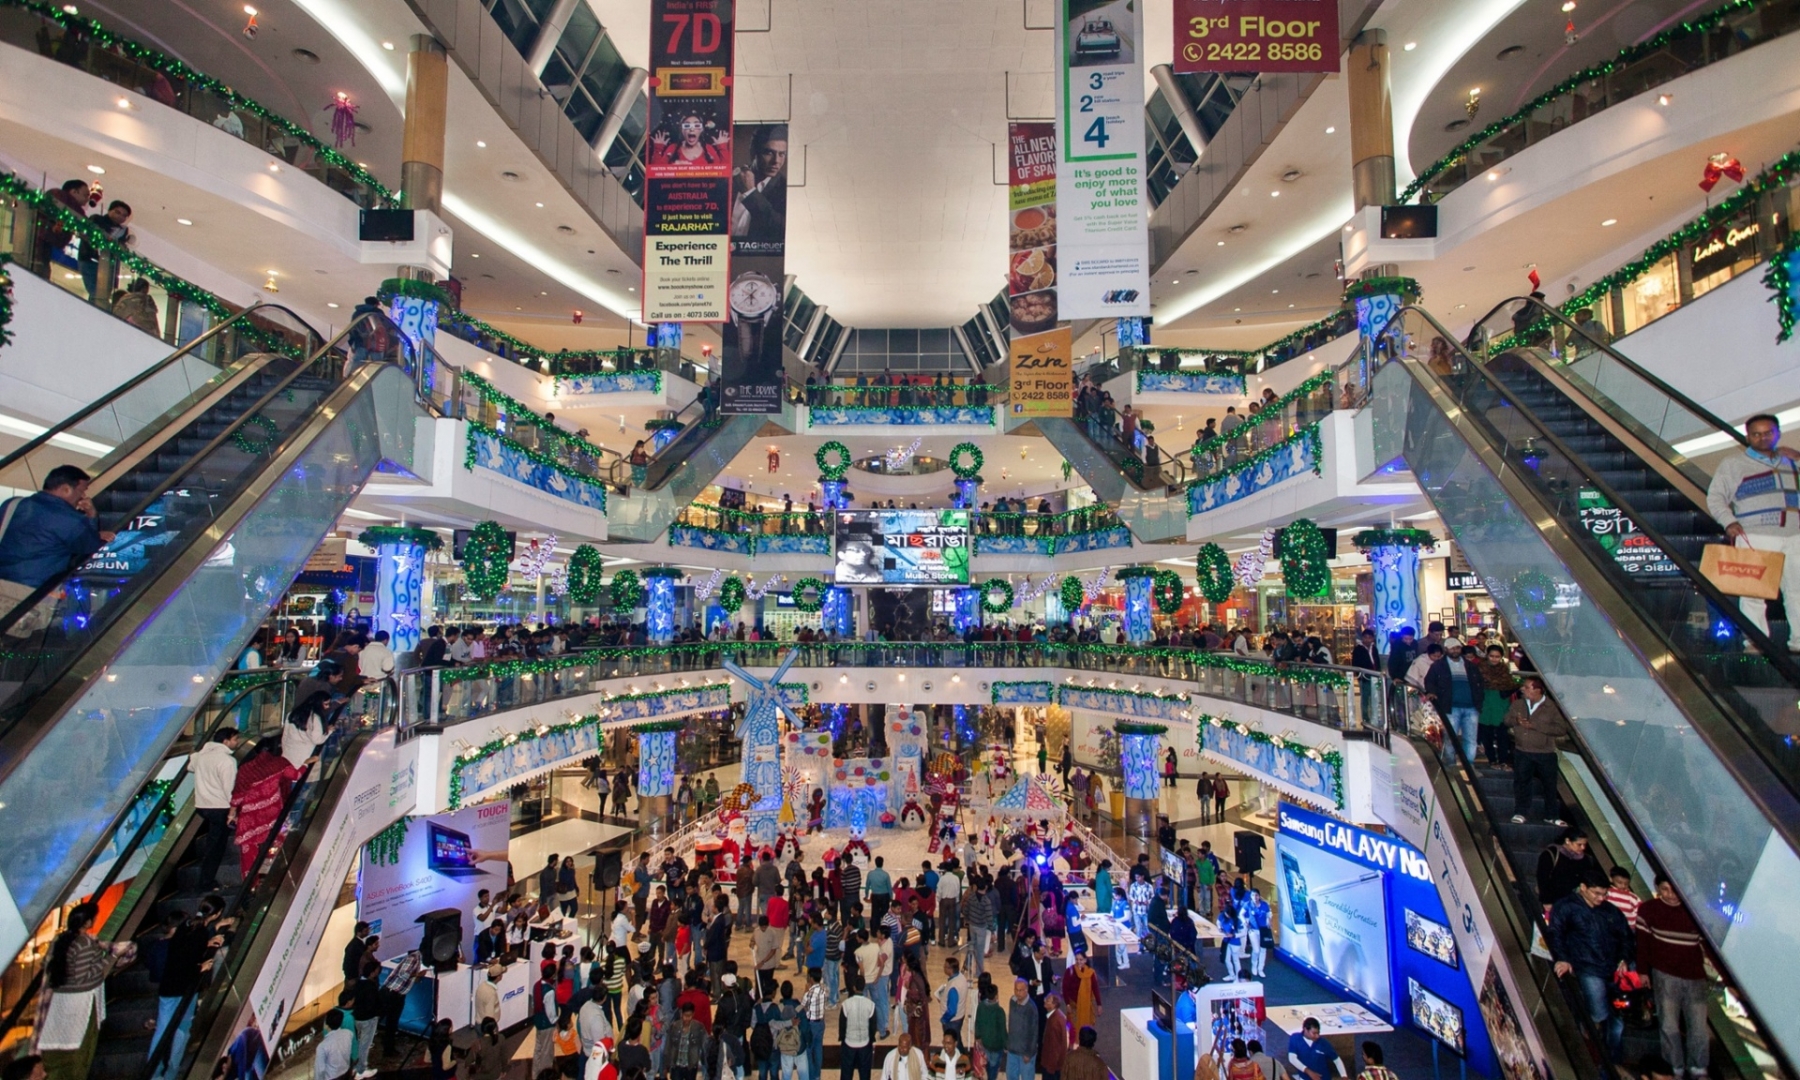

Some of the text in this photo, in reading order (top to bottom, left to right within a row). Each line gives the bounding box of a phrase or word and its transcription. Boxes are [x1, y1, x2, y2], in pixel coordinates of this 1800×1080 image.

[666, 1, 718, 9] India's FIRST
[662, 12, 721, 54] 7D
[1188, 16, 1320, 38] 3rd Floor
[1207, 42, 1322, 61] 2422 8586
[1090, 72, 1103, 90] 3
[1080, 95, 1094, 112] 2
[1084, 116, 1109, 148] 4
[1012, 135, 1026, 144] THE
[1014, 144, 1030, 154] ALL
[1016, 151, 1056, 168] FLAVOR
[1018, 166, 1030, 180] OF
[1074, 167, 1138, 179] It's good to
[1075, 177, 1138, 190] enjoy more
[668, 192, 708, 200] AUSTRALIA
[1096, 187, 1138, 198] of what
[664, 203, 702, 212] experience
[1091, 198, 1138, 210] you love
[656, 241, 717, 252] Experience
[660, 255, 712, 266] The Thrill
[1016, 354, 1068, 369] Zara
[1014, 380, 1069, 390] 3rd Floor
[1022, 392, 1070, 400] 2422 8586
[905, 572, 958, 580] Music Stores
[1449, 576, 1478, 587] U.S. POLO
[477, 804, 508, 819] TOUCH
[1280, 812, 1324, 846] Samsung
[1324, 823, 1397, 868] GALAXY
[366, 889, 385, 900] ASUS
[386, 880, 414, 896] VivoBook
[416, 876, 432, 887] S400
[258, 993, 269, 1016] It's
[268, 962, 284, 996] good
[283, 948, 290, 962] to
[289, 915, 304, 946] enjoy
[303, 888, 316, 914] more
[321, 850, 333, 874] what
[332, 834, 340, 850] you
[340, 813, 350, 832] love
[1324, 896, 1378, 928] Incredibly Creative
[1462, 904, 1472, 934] 3
[502, 986, 525, 1002] ASUS
